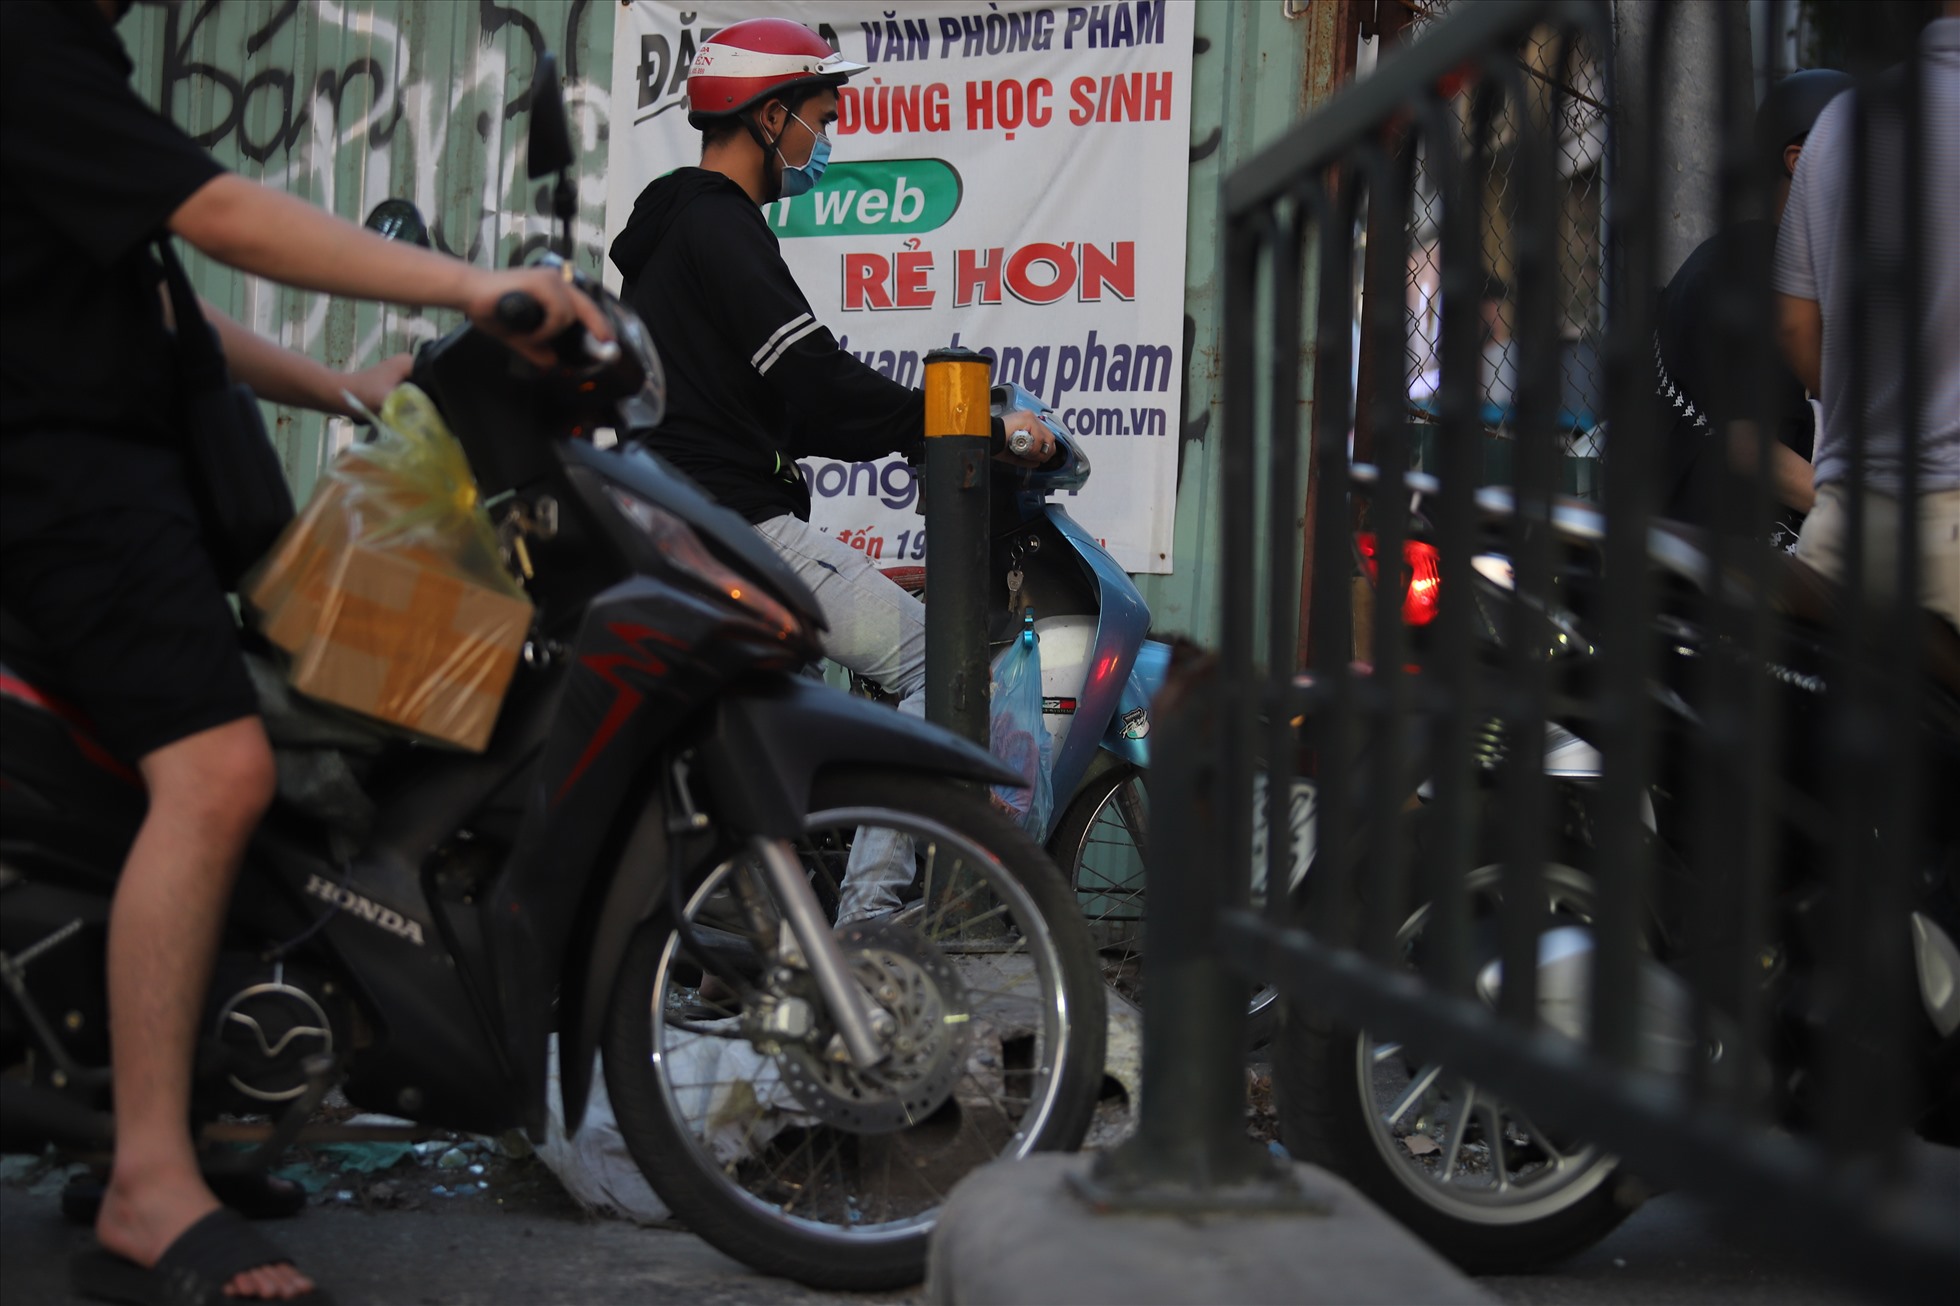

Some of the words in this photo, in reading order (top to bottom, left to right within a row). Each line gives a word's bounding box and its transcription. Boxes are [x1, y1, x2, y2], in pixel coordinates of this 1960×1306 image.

[637, 12, 724, 109] ĐẶ
[860, 10, 930, 63] VĂN
[938, 2, 1055, 59] PHÒNG
[837, 77, 950, 135] DÙNG
[966, 78, 1053, 141] HỌC
[1069, 71, 1173, 127] SINH
[814, 177, 925, 225] web
[841, 237, 936, 312] RẺ
[953, 240, 1135, 309] HƠN
[1051, 330, 1173, 409] pham
[305, 873, 425, 946] HONDA
